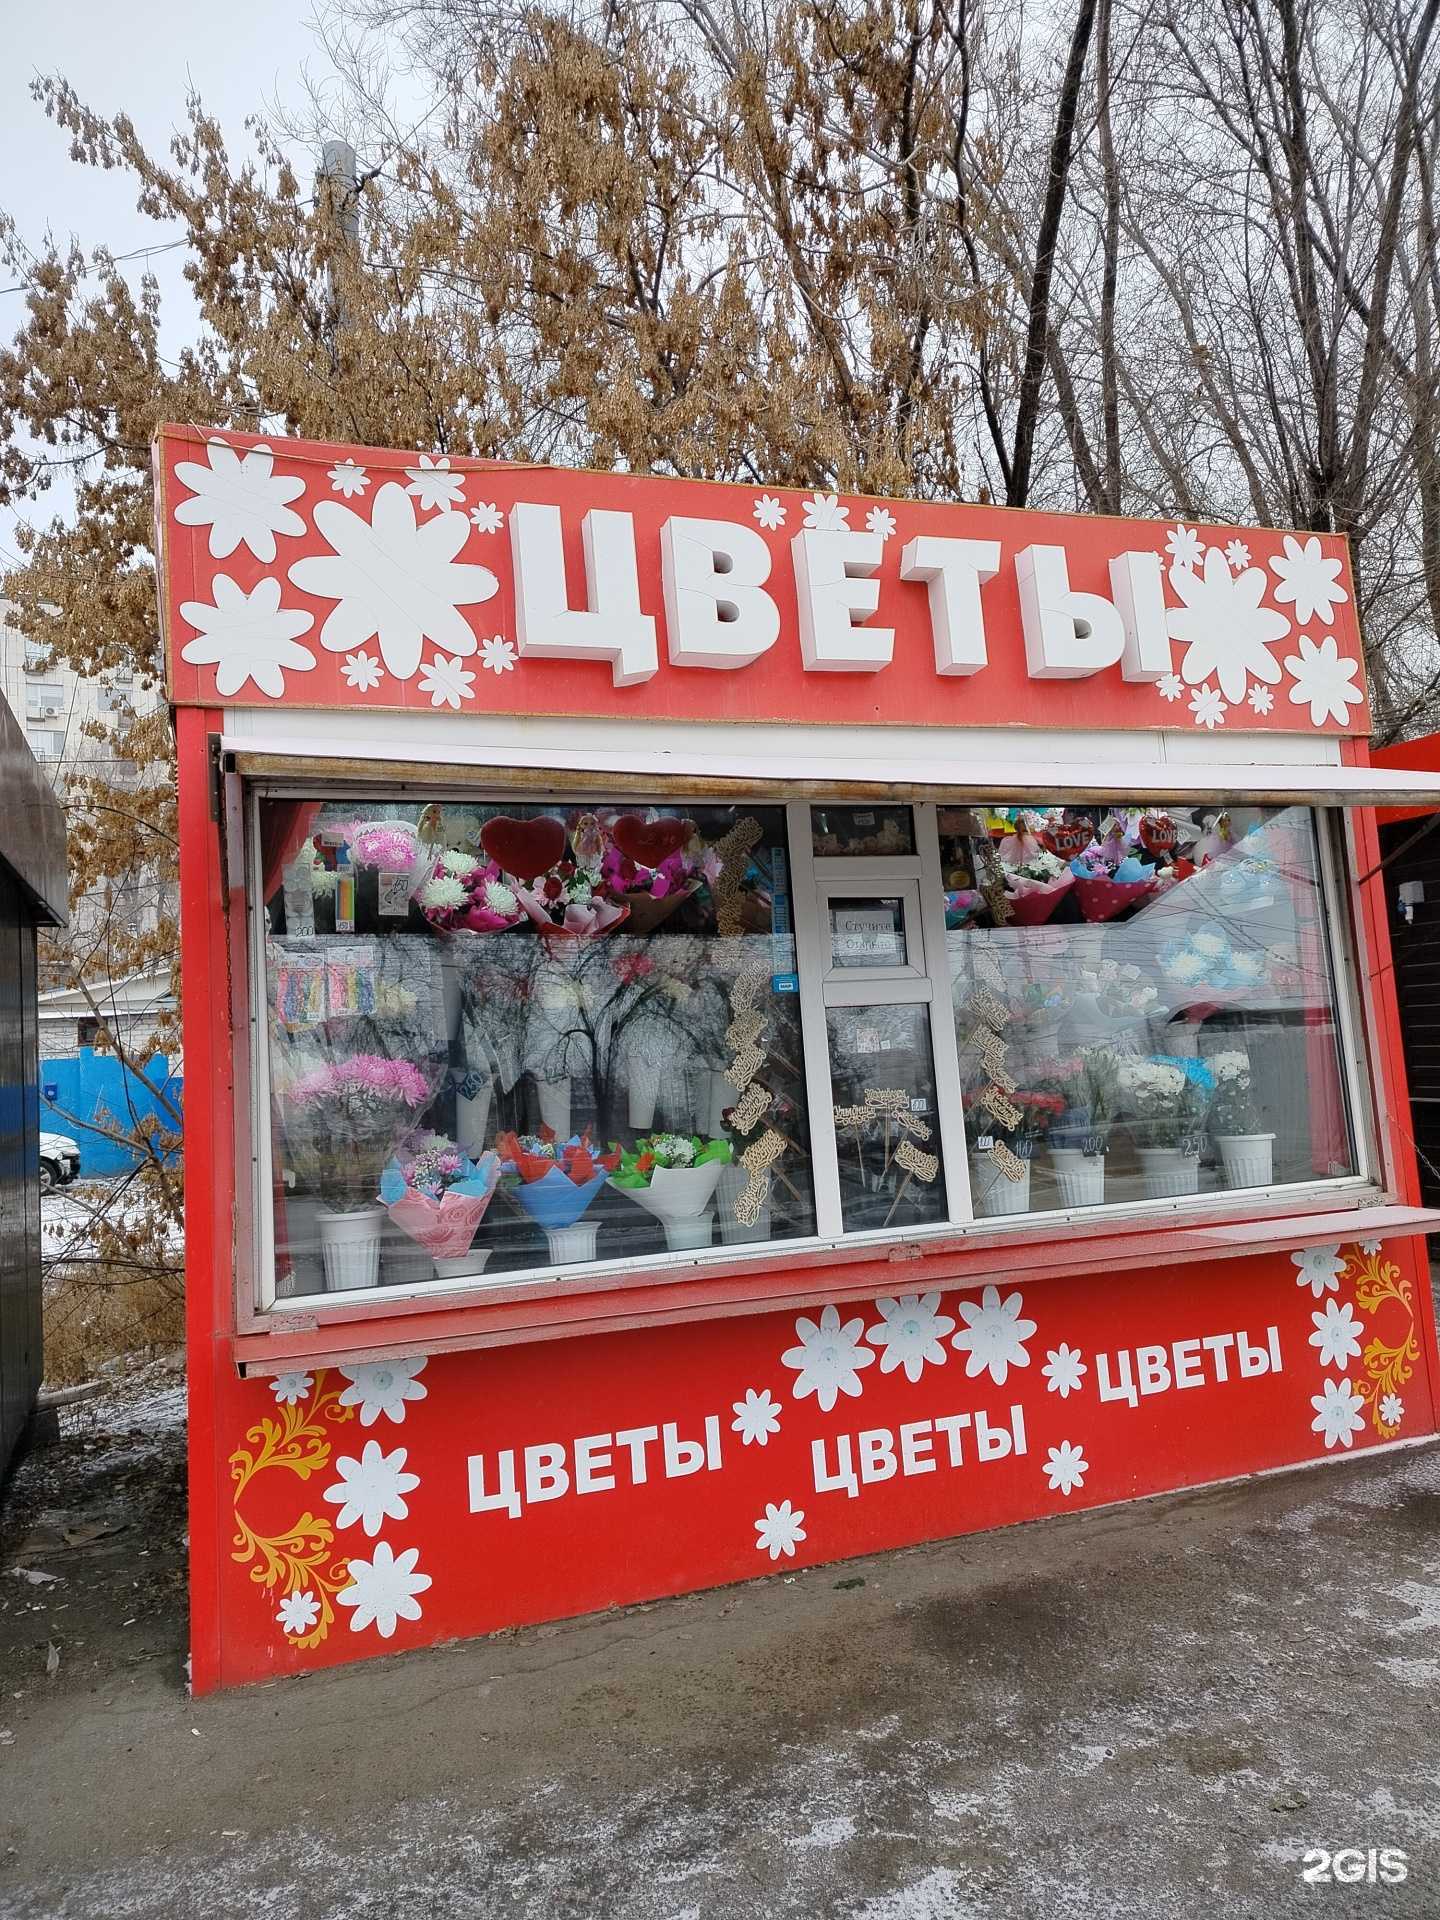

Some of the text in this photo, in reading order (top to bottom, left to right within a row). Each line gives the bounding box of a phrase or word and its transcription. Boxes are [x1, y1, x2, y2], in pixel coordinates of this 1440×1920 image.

[509, 502, 1172, 687] ЦВЕТЫ
[1055, 832, 1090, 850] LOVE
[1152, 829, 1178, 843] LOVE
[1183, 1135, 1207, 1156] 250
[1096, 1326, 1283, 1408] ЦВЕТЫ
[467, 1415, 723, 1519] ЦВЕТЫ
[811, 1404, 1028, 1498] ЦВЕТЫ
